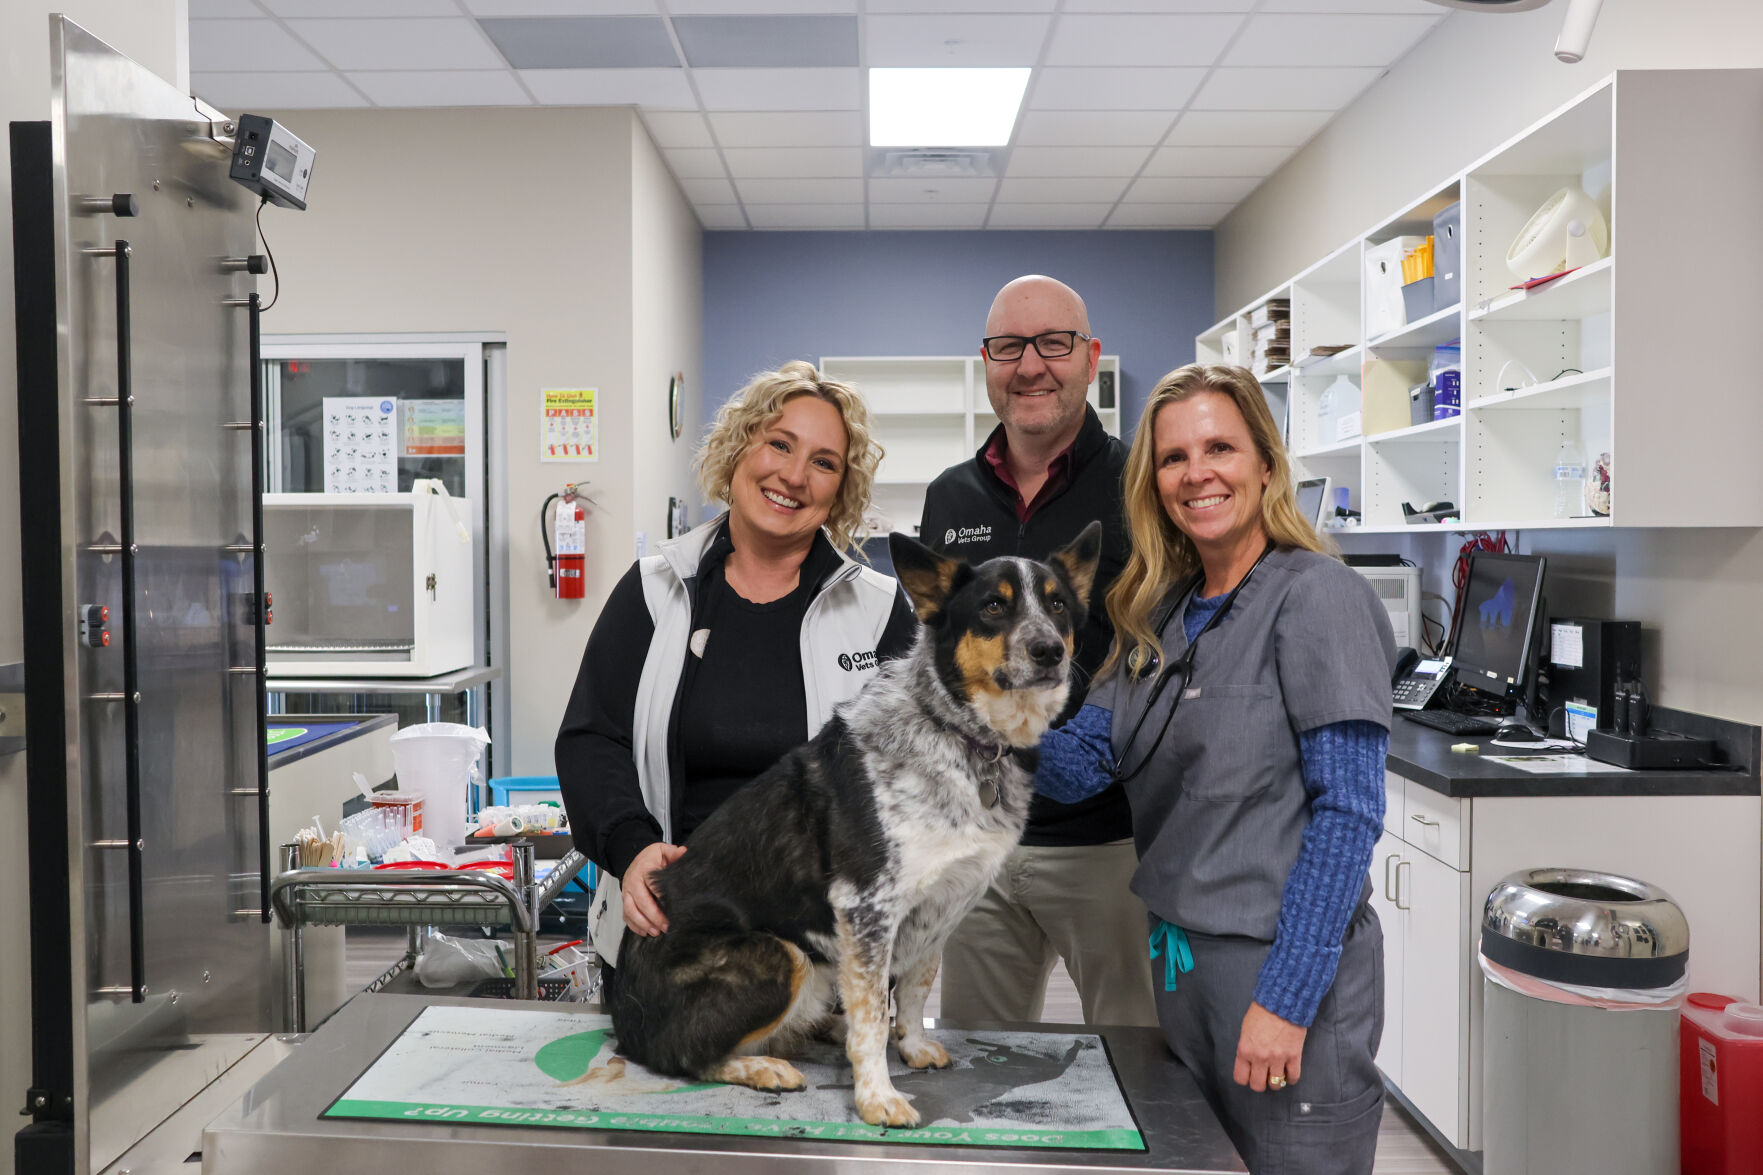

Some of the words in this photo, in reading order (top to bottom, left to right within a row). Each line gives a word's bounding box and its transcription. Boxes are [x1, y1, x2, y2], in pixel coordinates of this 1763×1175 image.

[958, 524, 992, 537] Omaha
[851, 650, 879, 663] Oma
[855, 662, 875, 671] Vets
[403, 1106, 470, 1118] Up?
[477, 1109, 600, 1125] Getting
[899, 1129, 973, 1142] Your
[983, 1132, 1065, 1143] Does
